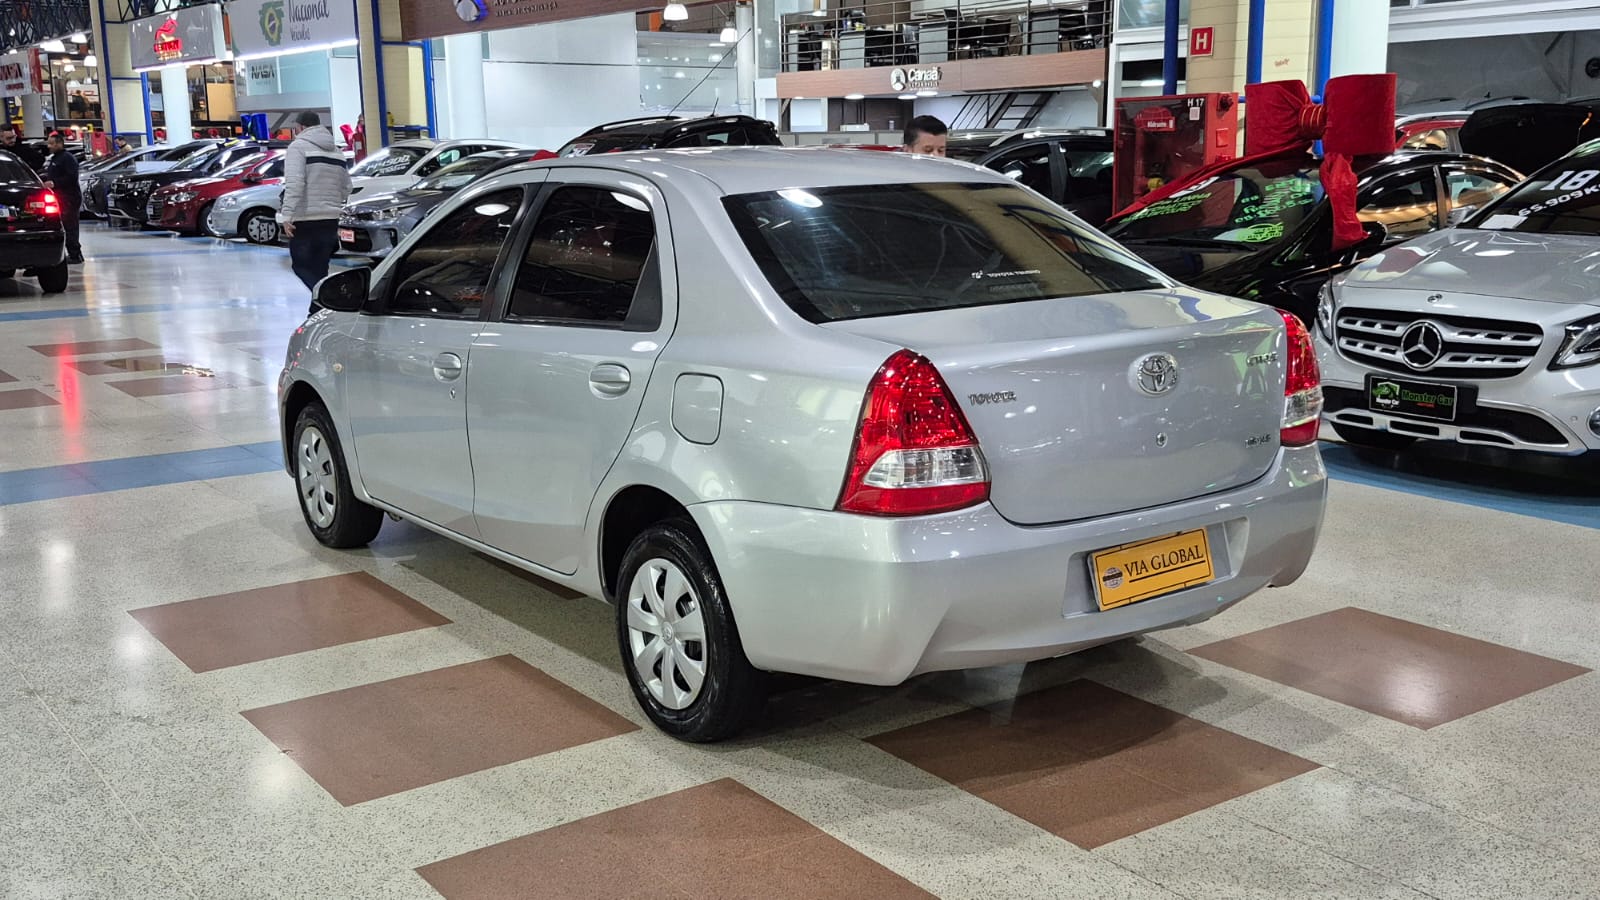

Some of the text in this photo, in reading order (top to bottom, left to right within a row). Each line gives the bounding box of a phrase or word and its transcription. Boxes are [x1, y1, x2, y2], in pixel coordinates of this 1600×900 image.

[289, 0, 329, 22] Nacional
[1195, 32, 1208, 50] H
[908, 66, 938, 81] Canaã
[1187, 98, 1205, 107] H 17
[1540, 169, 1600, 191] 18
[968, 391, 1016, 406] TOYOTA
[1124, 545, 1204, 577] VIA GLOBAL
